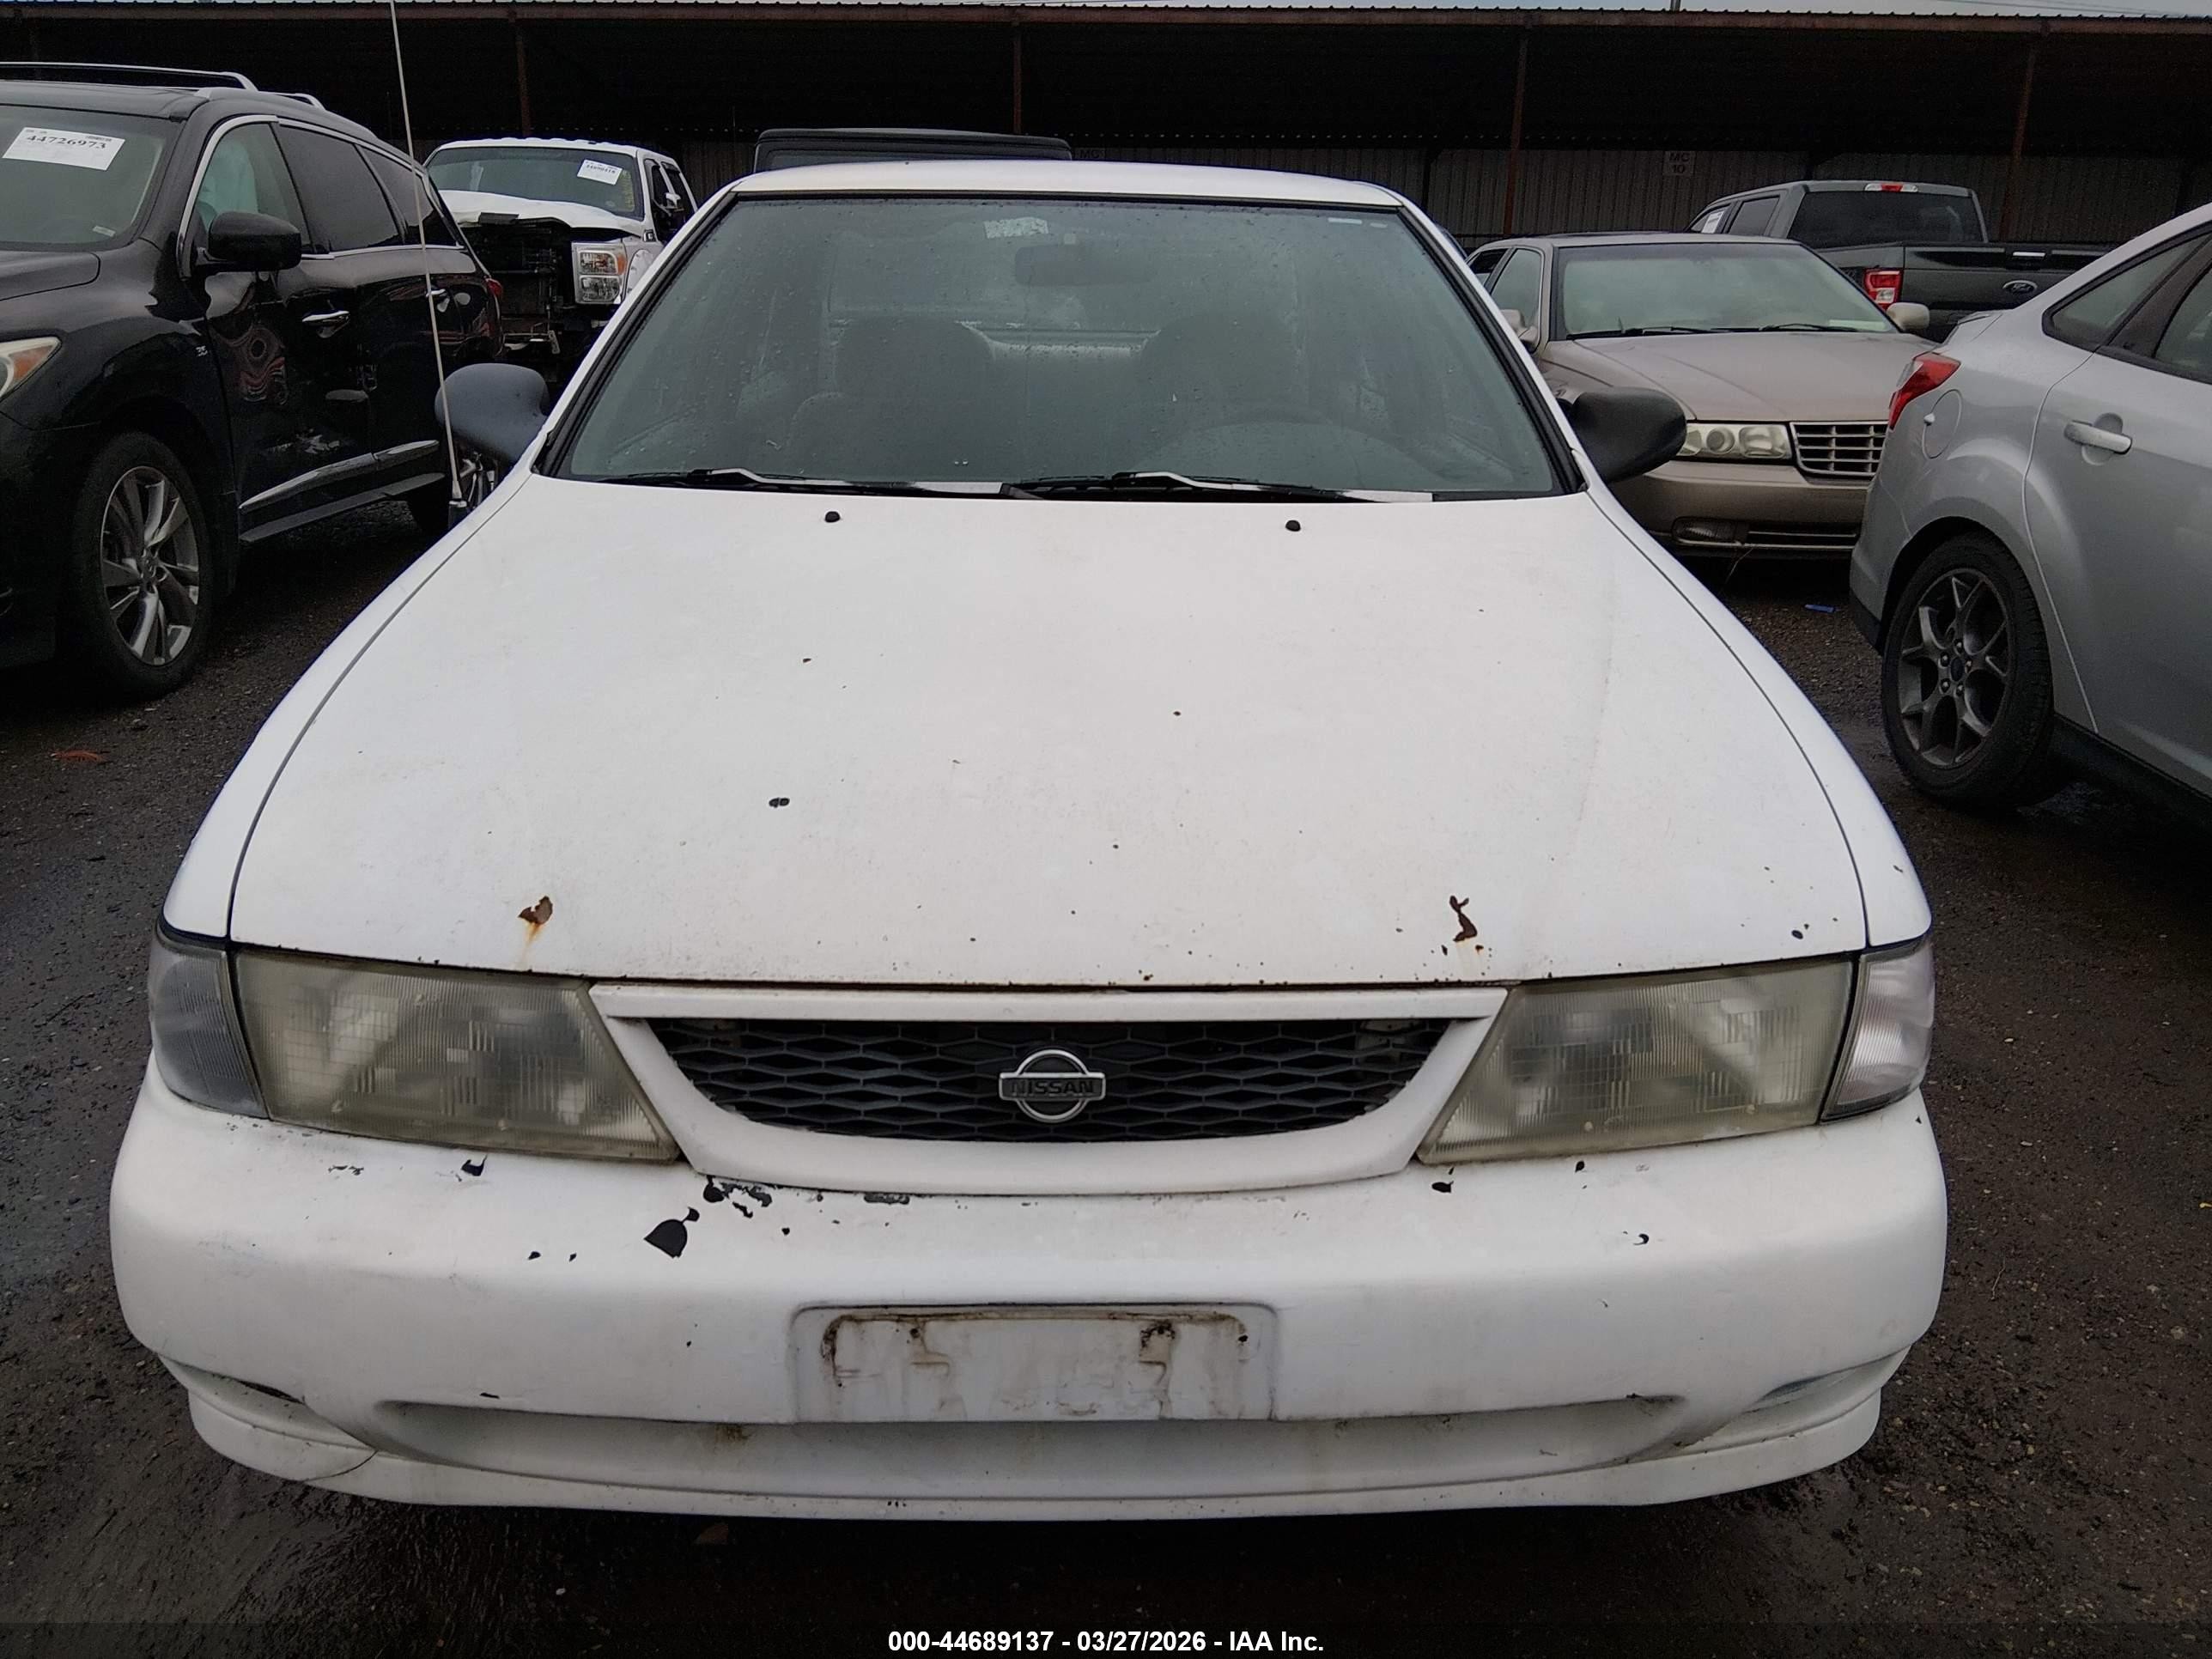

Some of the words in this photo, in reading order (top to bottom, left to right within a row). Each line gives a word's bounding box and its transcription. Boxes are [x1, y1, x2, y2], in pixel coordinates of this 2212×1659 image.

[27, 135, 106, 150] 44726973
[1669, 152, 1691, 162] MC
[1012, 1079, 1093, 1094] NISSAN
